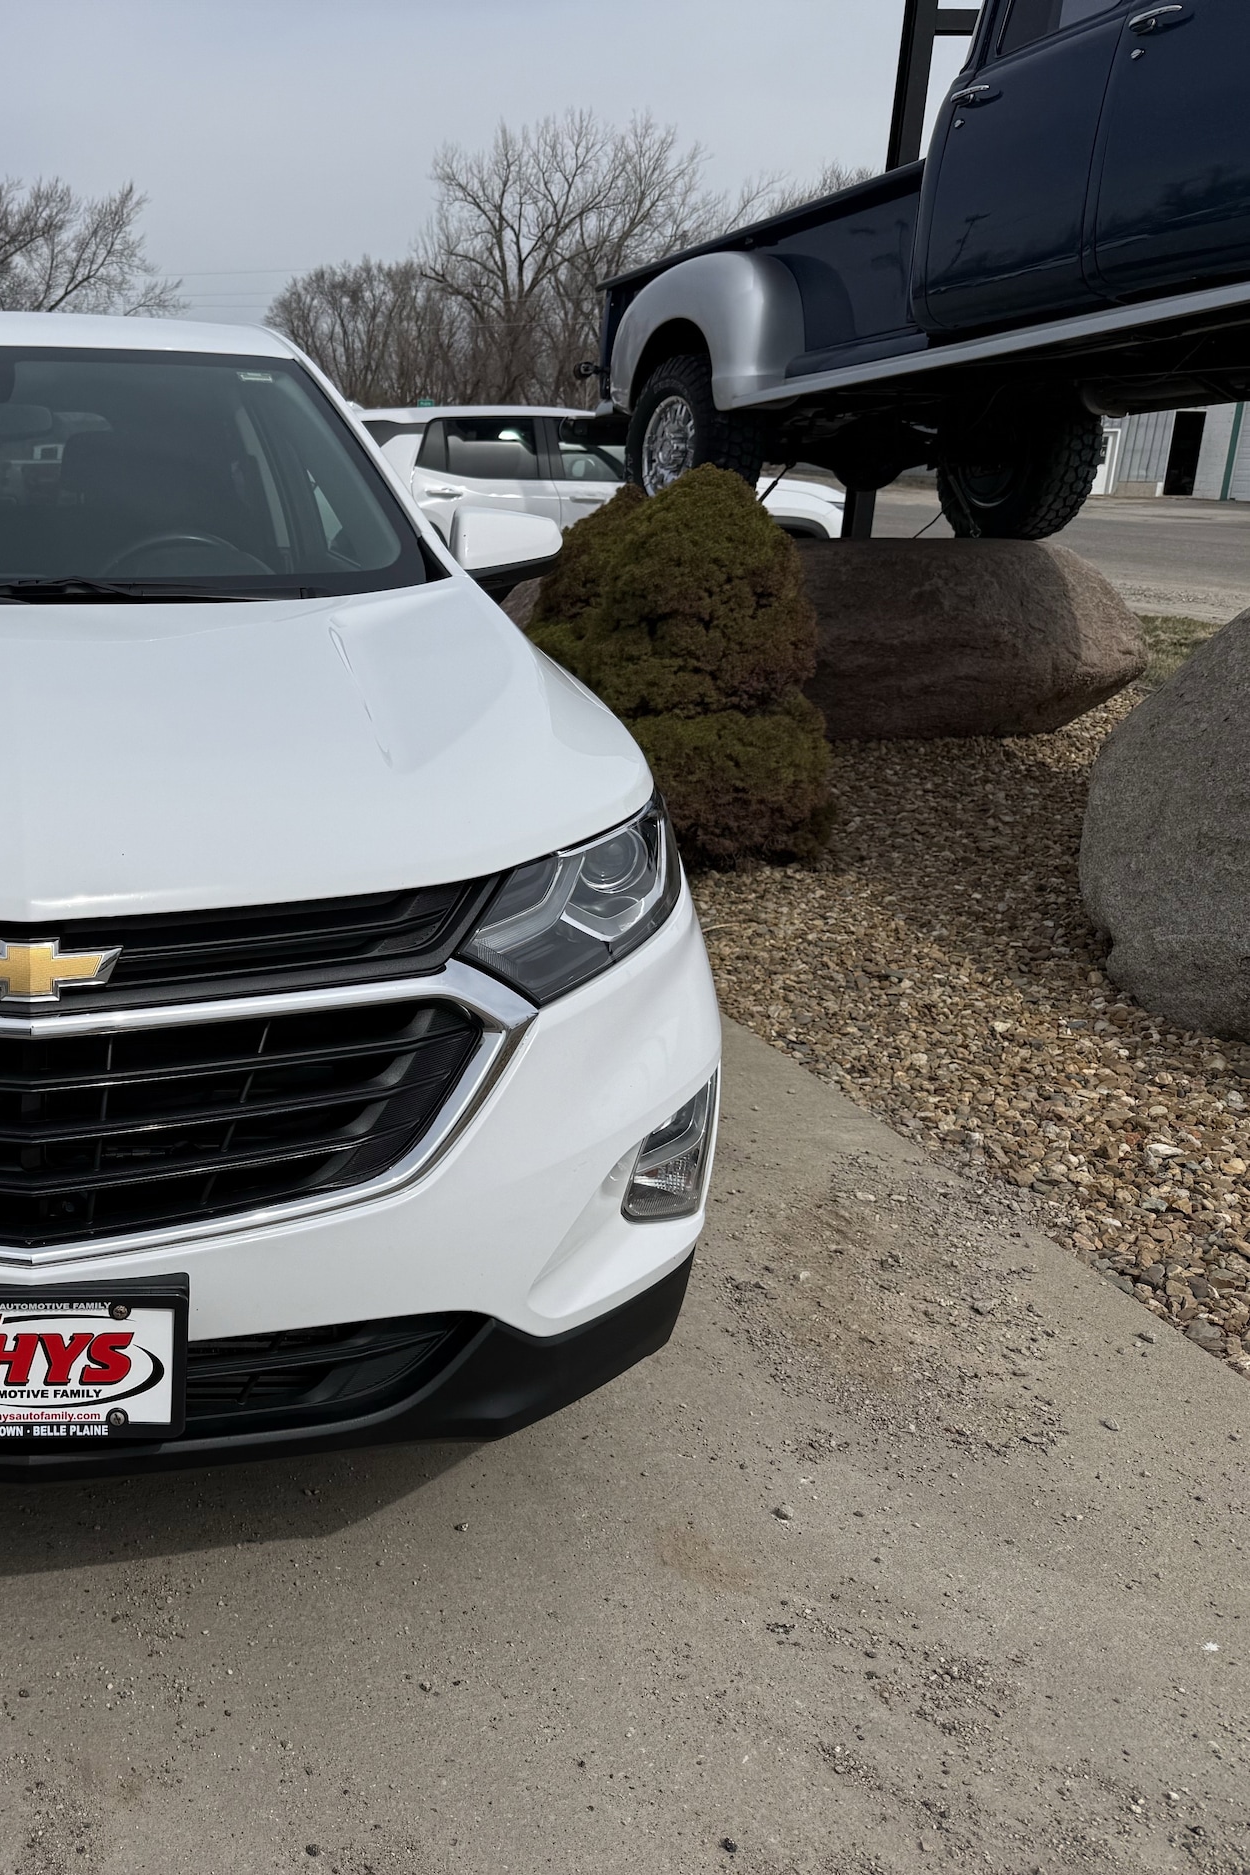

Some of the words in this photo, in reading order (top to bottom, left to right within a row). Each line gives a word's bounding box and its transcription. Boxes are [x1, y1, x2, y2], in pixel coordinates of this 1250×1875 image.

[0, 1302, 70, 1310] AUTOMOTIVE
[73, 1302, 111, 1310] FAMILY
[53, 1389, 102, 1398] FAMILY
[33, 1425, 67, 1436] BELLE
[69, 1425, 108, 1436] PLAINE
